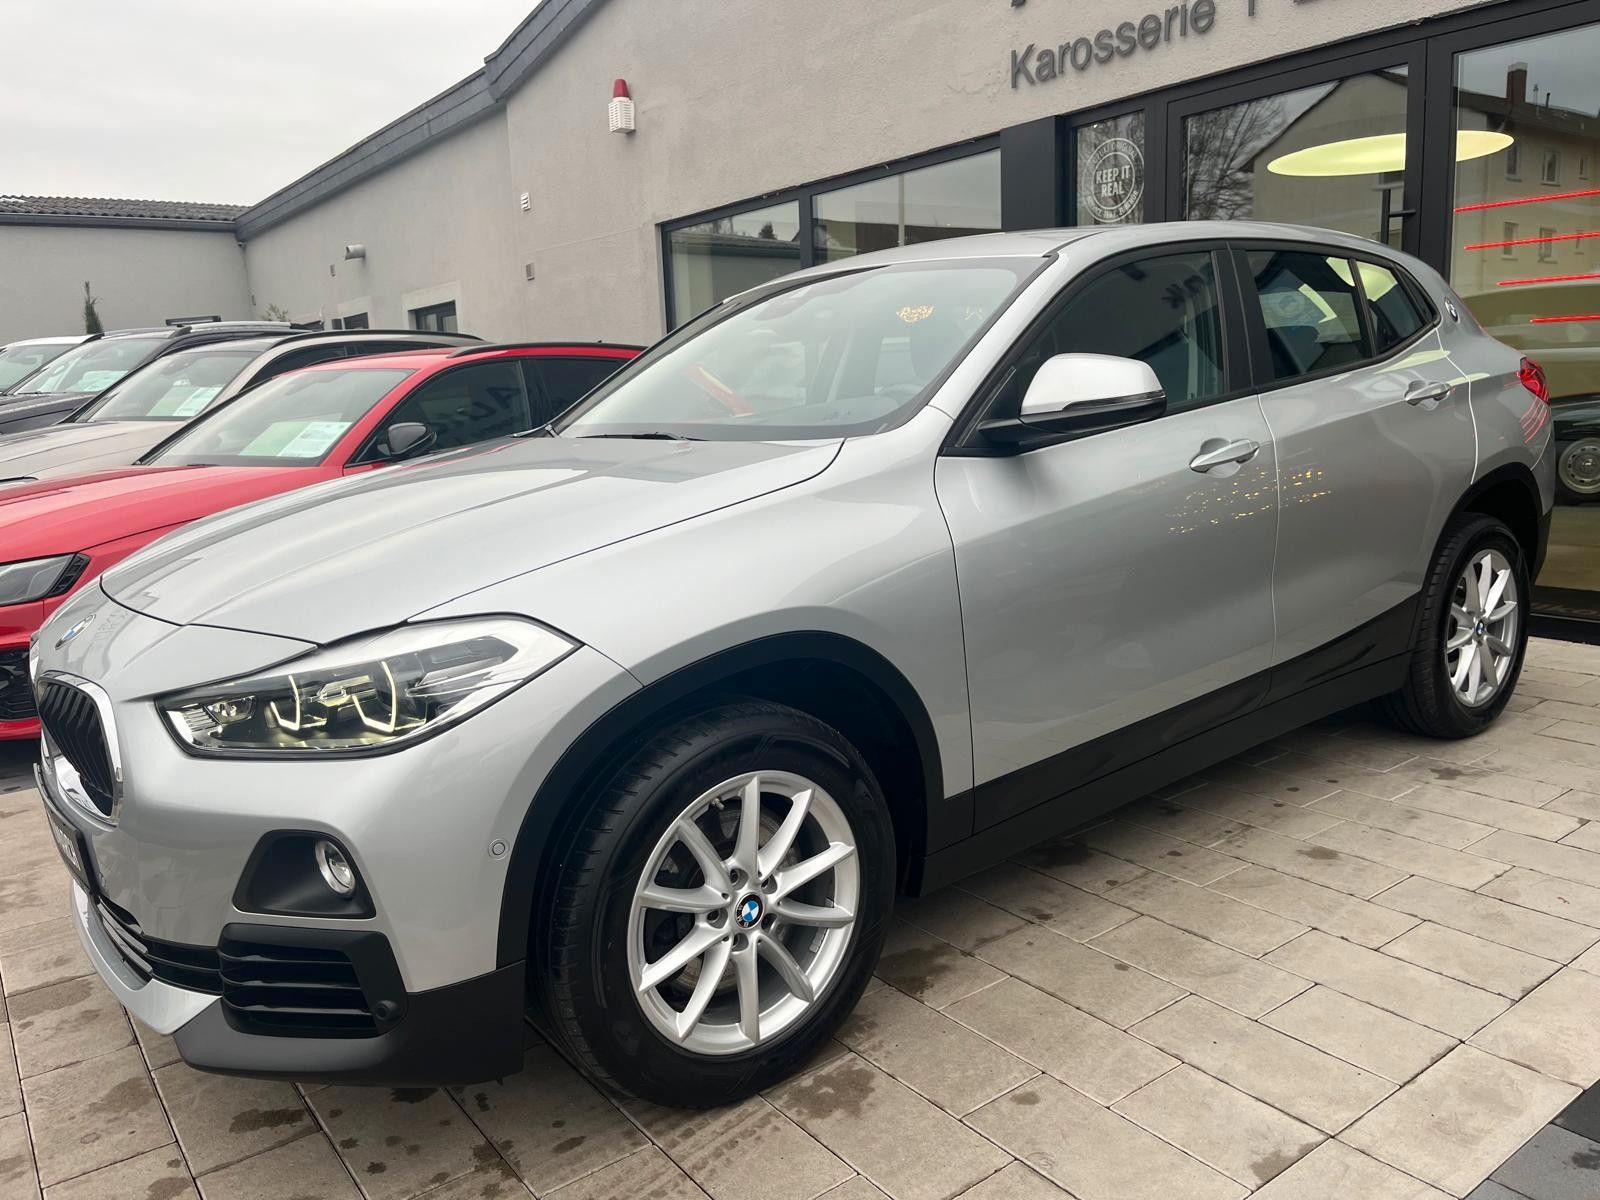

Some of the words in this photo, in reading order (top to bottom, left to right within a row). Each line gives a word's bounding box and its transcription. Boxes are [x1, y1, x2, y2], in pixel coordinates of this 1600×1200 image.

[1010, 0, 1216, 89] Karosserie
[1096, 168, 1119, 184] KEEP
[1121, 165, 1131, 179] IT
[1101, 182, 1125, 197] REAL
